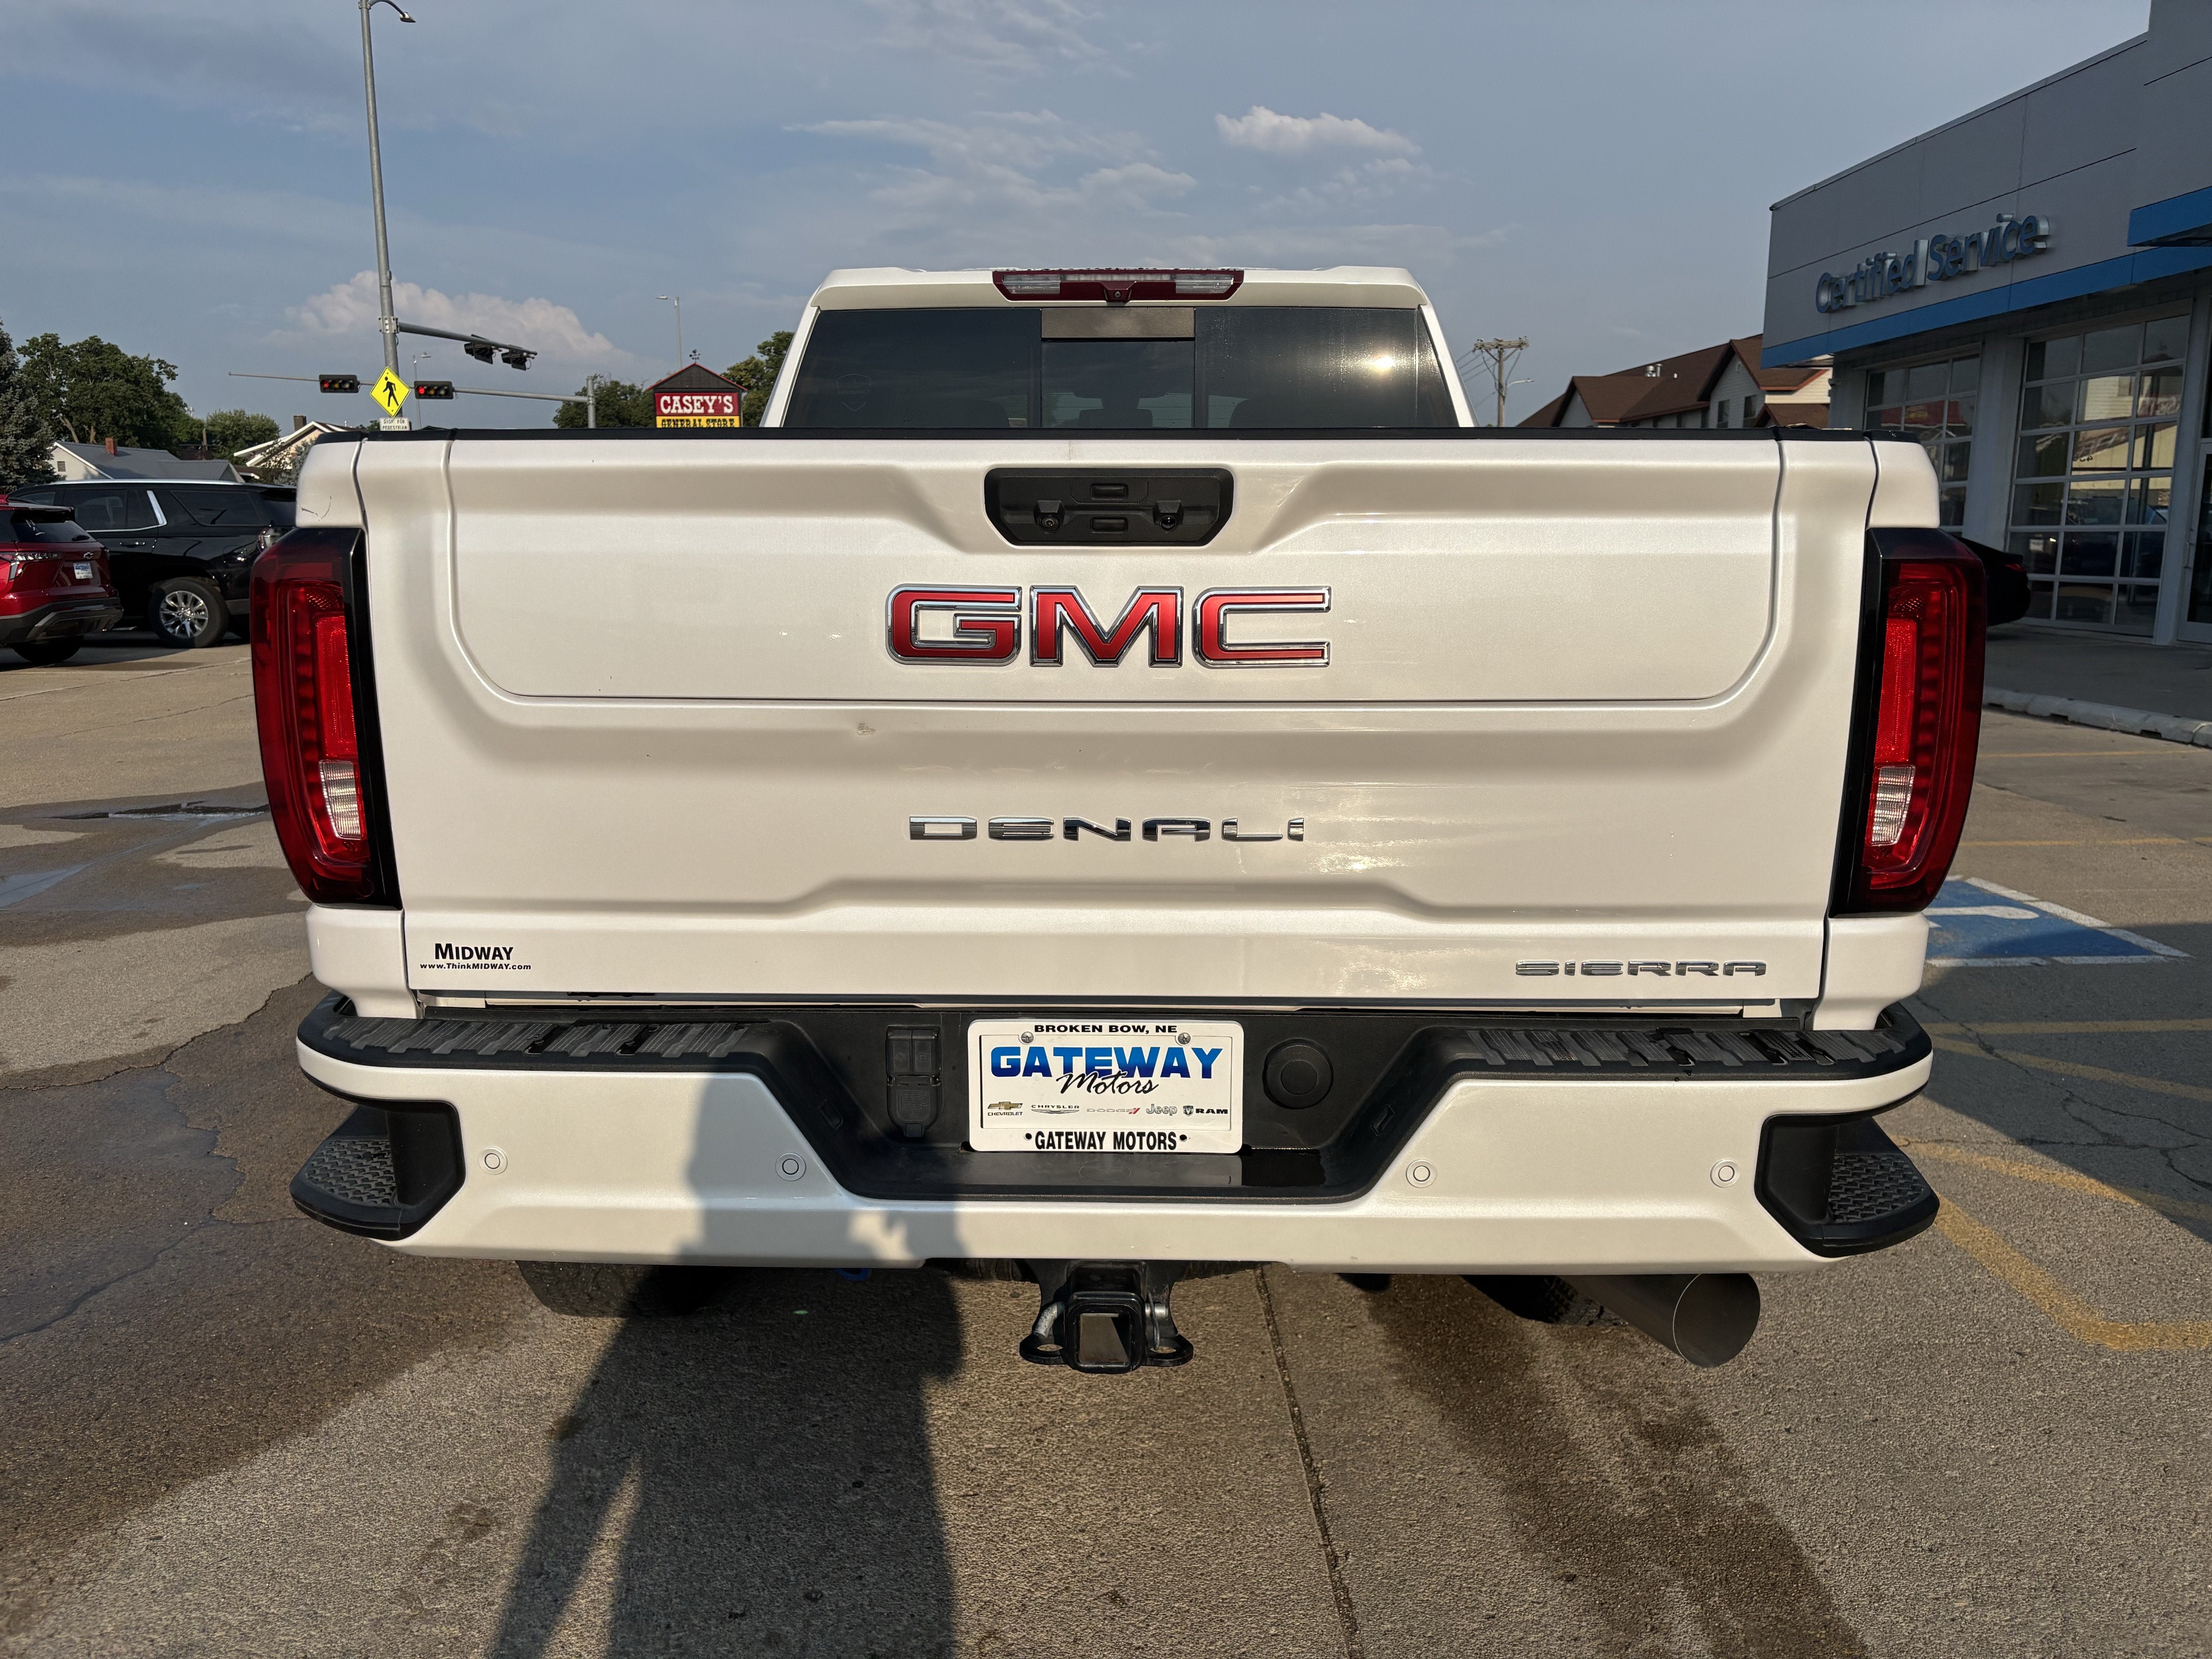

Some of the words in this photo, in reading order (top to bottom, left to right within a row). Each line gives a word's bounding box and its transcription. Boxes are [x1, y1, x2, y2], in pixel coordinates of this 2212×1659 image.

[1816, 239, 1929, 313] Certified
[1927, 213, 2050, 281] Service
[660, 395, 733, 414] CASEY'S
[661, 419, 703, 428] GENERAL
[706, 418, 735, 428] STORE
[885, 584, 1331, 668] GMC
[909, 816, 1304, 842] DENALI
[435, 943, 514, 960] MIDWAY
[1515, 960, 1767, 976] SIERRA
[1034, 1025, 1103, 1033] BROKEN
[1109, 1025, 1149, 1034] BOW,
[991, 1046, 1223, 1079] GATEWAY
[1056, 1070, 1159, 1094] Motors
[1146, 1104, 1178, 1116] Jeep
[1035, 1131, 1106, 1150] GATEWAY
[1113, 1131, 1177, 1150] MOTORS
